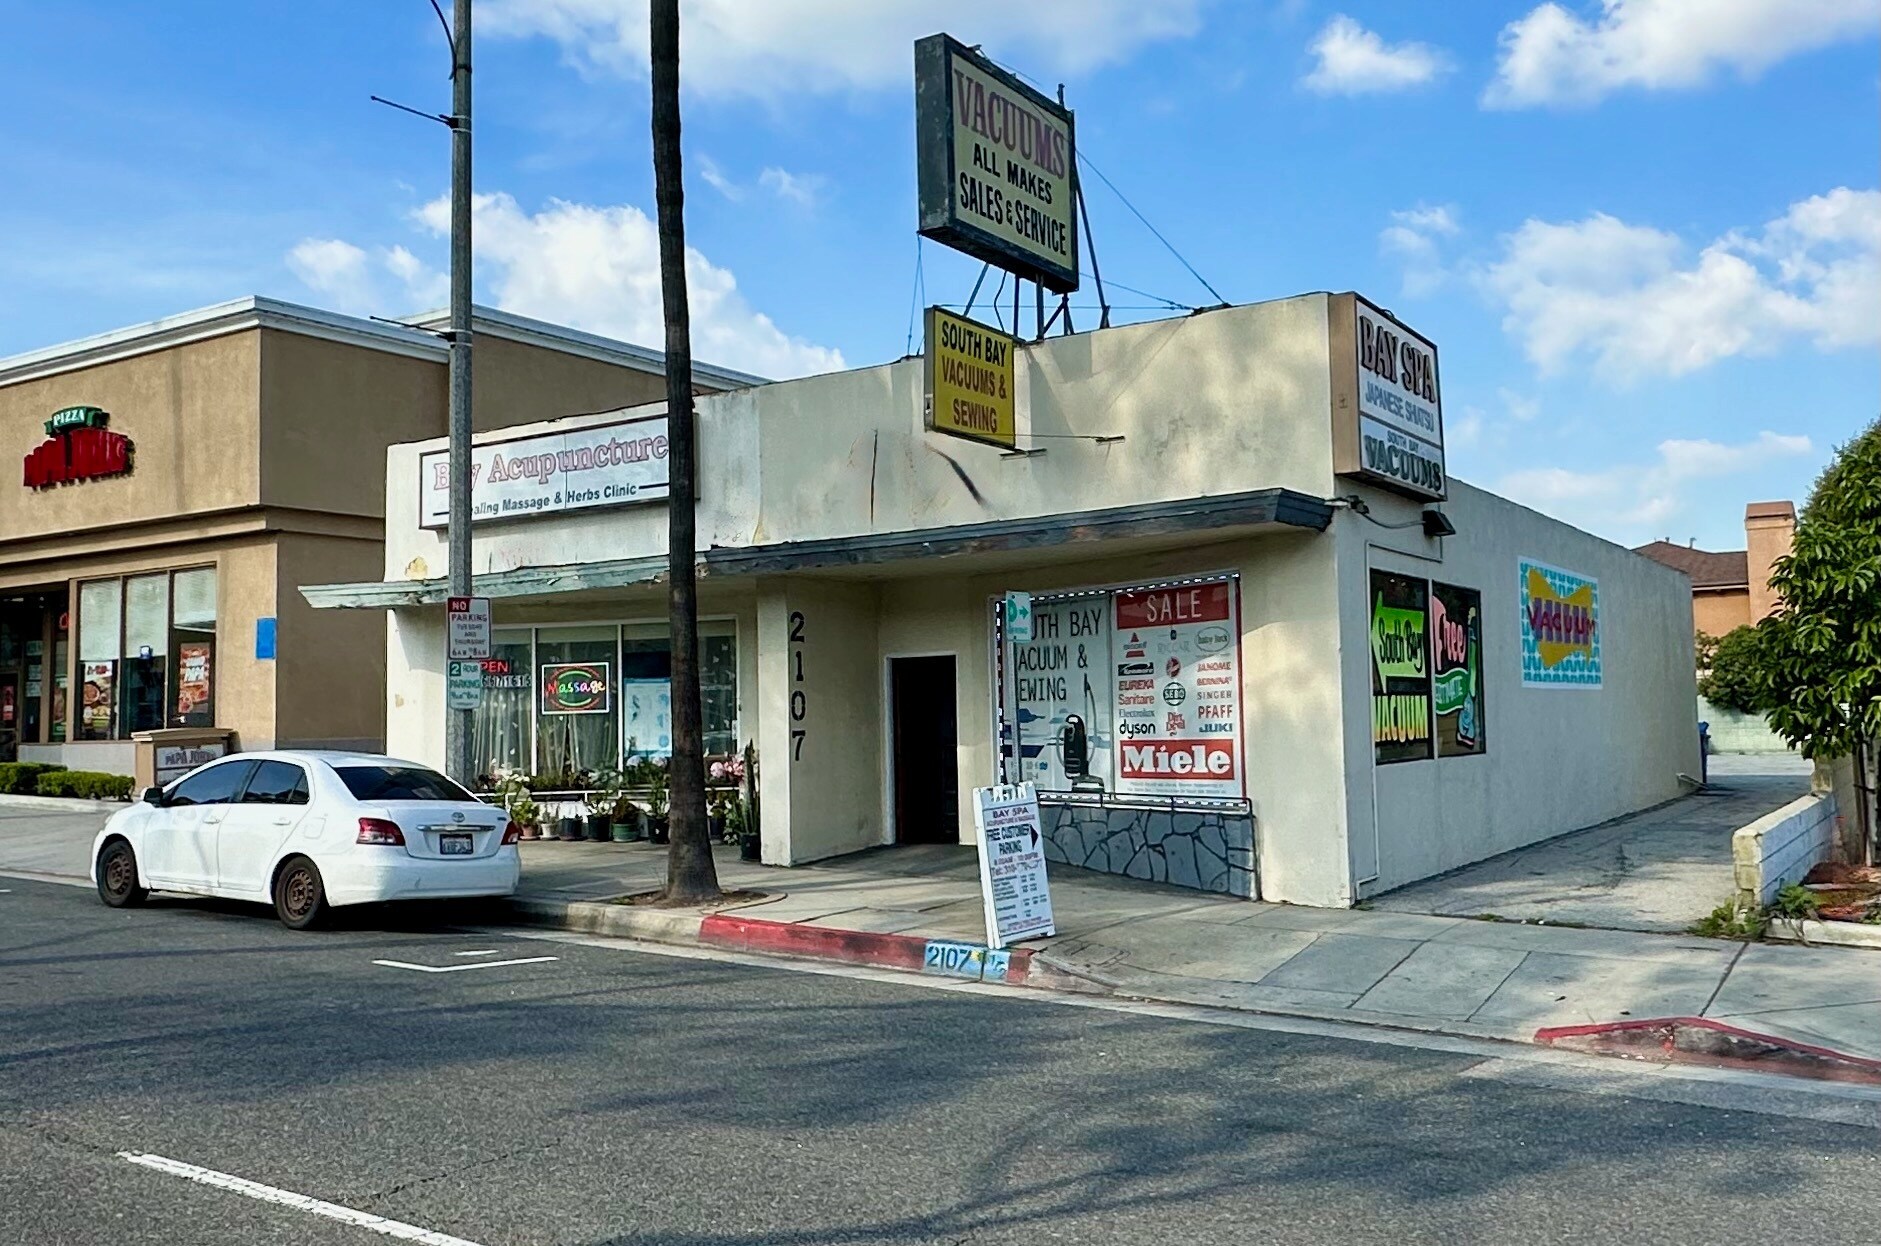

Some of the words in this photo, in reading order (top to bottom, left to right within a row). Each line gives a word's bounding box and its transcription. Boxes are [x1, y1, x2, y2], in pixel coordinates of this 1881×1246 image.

[954, 70, 1064, 180] VACUUMS
[973, 143, 1000, 177] ALL
[1007, 160, 1052, 204] MAKES
[960, 172, 1003, 225] SALES
[1006, 199, 1013, 225] &
[1015, 199, 1066, 255] SERVICE
[942, 320, 981, 360] SOUTH
[985, 336, 1007, 367] BAY
[1360, 315, 1399, 384] BAY
[1401, 341, 1436, 403] SPA
[942, 355, 995, 397] VACUUMS
[999, 374, 1007, 399] &
[1365, 381, 1404, 418] JAPANESE
[53, 408, 85, 426] PIZZA
[953, 398, 997, 434] SEWING
[1387, 430, 1407, 449] SOUTH
[433, 462, 482, 492] By
[488, 435, 669, 485] Acupuncture
[1364, 434, 1442, 491] VACUUMS
[472, 502, 499, 515] aling
[502, 495, 550, 512] Massage
[554, 493, 562, 504] &
[566, 485, 600, 503] Herbs
[603, 482, 637, 497] Clinic
[451, 613, 487, 622] PARKING
[452, 601, 467, 611] NO
[1146, 589, 1202, 623] SALE
[1526, 603, 1598, 637] VACUUM
[1070, 608, 1102, 637] BAY
[1433, 595, 1467, 671] Free
[1018, 645, 1067, 671] ACUUM
[1078, 643, 1088, 668] &
[1379, 617, 1405, 664] South
[1404, 619, 1424, 673] Bay
[451, 664, 460, 675] 2
[479, 660, 508, 673] PEN
[545, 680, 606, 697] Massage
[790, 611, 806, 762] 2107
[1019, 677, 1067, 702] EWING
[1118, 678, 1155, 691] EUREKA
[1197, 690, 1232, 700] SINGER
[1118, 693, 1155, 706] Sanitaire
[1198, 705, 1233, 719] PFAFF
[1119, 719, 1156, 740] dyson
[1199, 723, 1233, 733] JUKI
[1373, 694, 1429, 743] VACUUM
[165, 751, 187, 765] PAPA
[1122, 745, 1231, 775] Miele
[993, 809, 1010, 818] BAY
[1012, 806, 1029, 816] SPA
[999, 840, 1022, 855] PARKING
[927, 946, 972, 972] 2107
